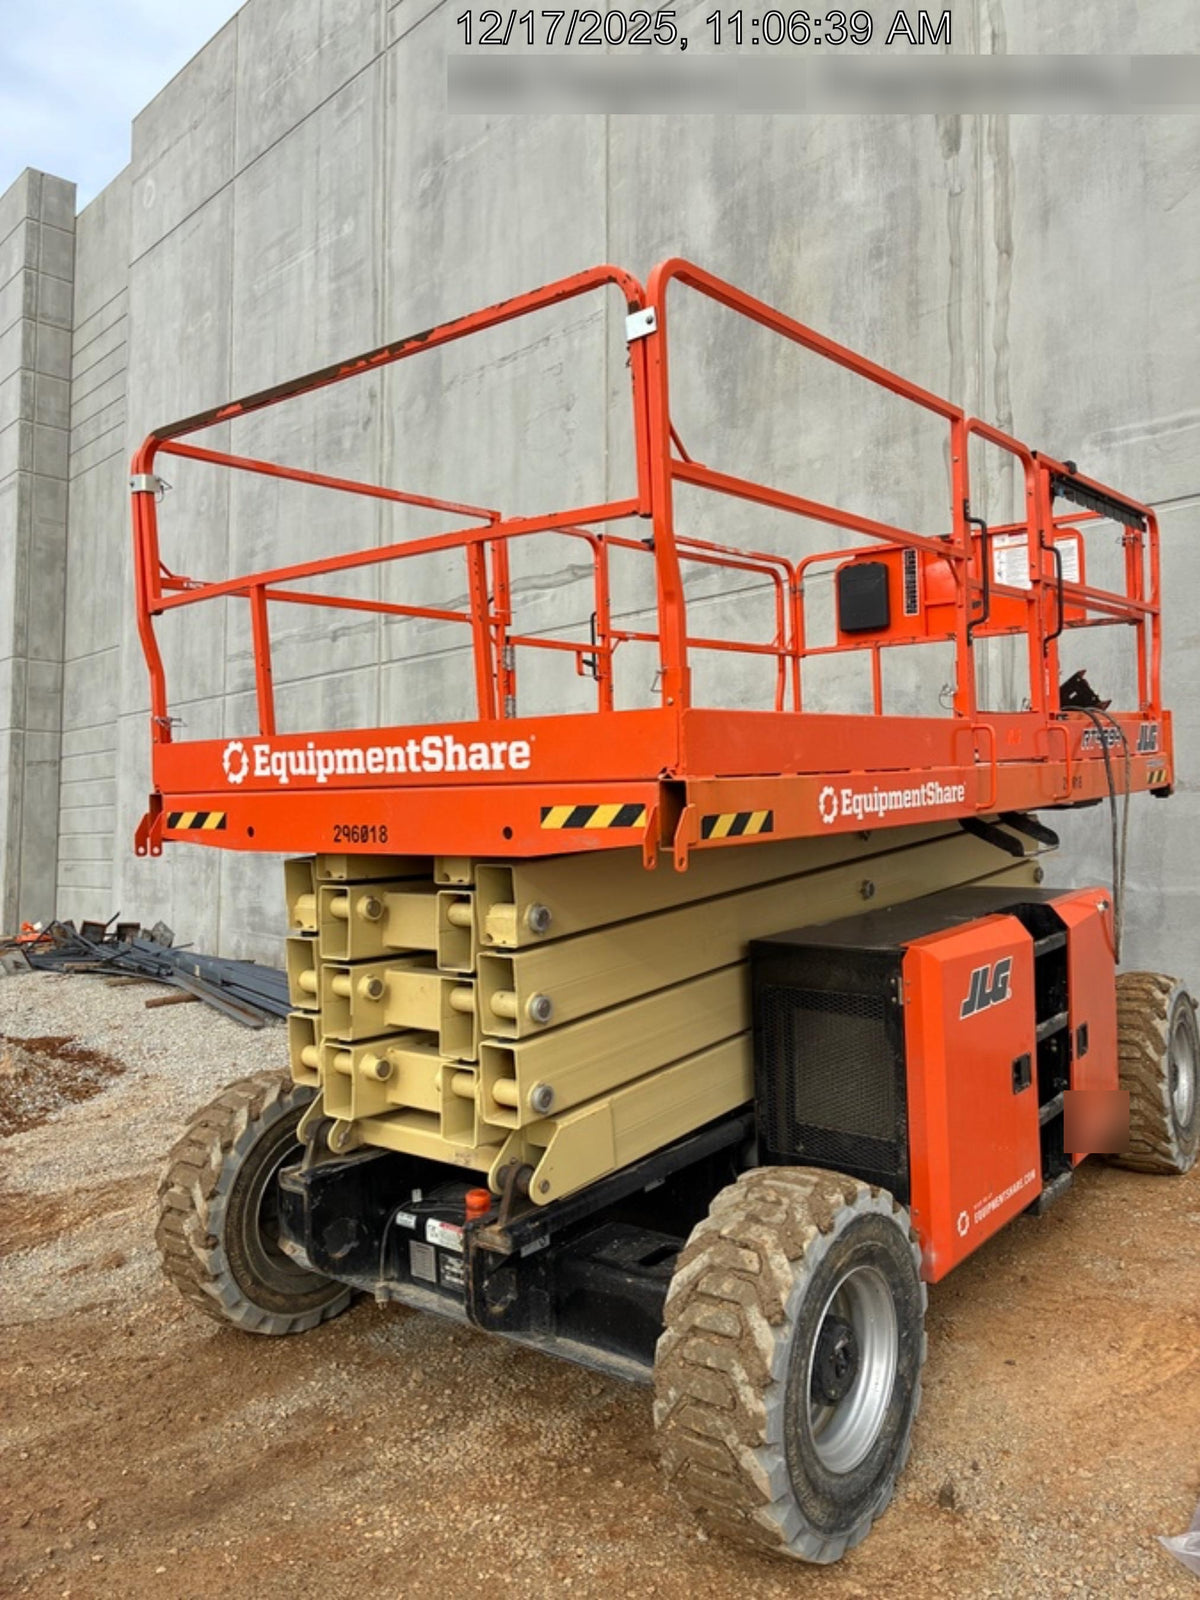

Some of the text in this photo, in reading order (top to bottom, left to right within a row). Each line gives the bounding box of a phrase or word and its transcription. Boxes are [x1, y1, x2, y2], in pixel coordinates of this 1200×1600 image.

[1136, 722, 1159, 753] JLG
[253, 735, 531, 784] EquipmentShare
[840, 781, 966, 821] EquipmentShare
[333, 824, 389, 844] 296018
[959, 955, 1013, 1020] JLG
